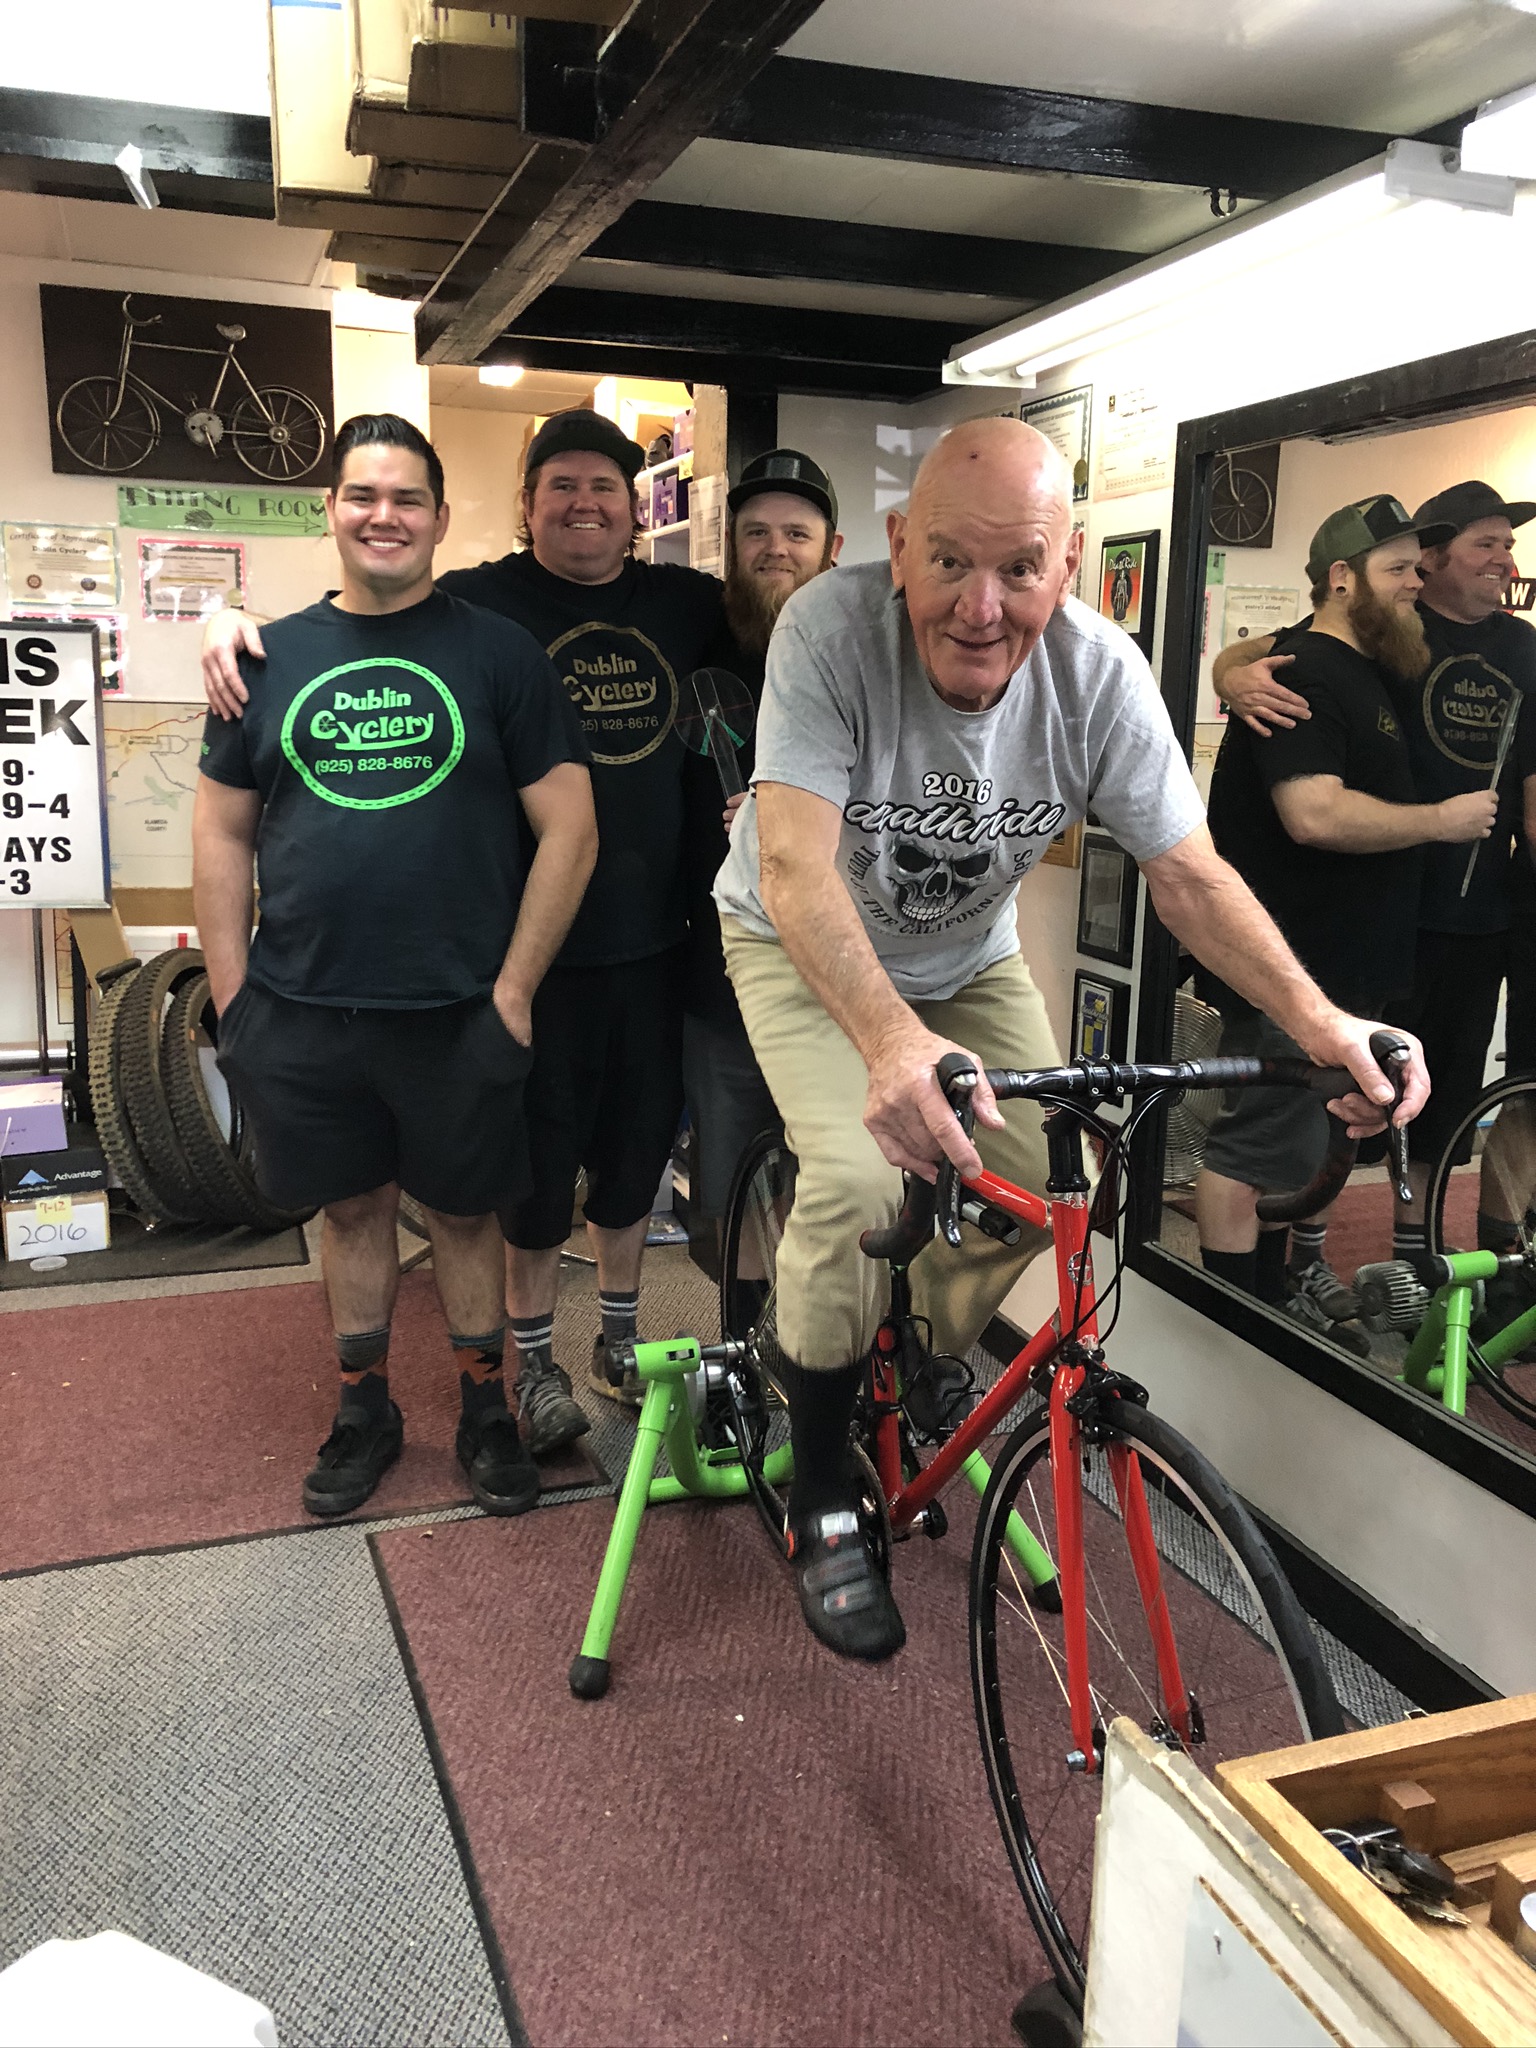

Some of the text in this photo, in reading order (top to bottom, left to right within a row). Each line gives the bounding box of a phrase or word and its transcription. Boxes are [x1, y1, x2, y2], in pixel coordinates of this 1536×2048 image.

[573, 653, 637, 675] Dublin
[333, 687, 412, 711] Dublin
[562, 675, 657, 712] Cyclery
[309, 710, 435, 751] Cyclery
[580, 715, 659, 732] 25) 828-8676
[314, 756, 433, 776] (925) 828-8676
[923, 772, 993, 804] 2016
[861, 898, 899, 927] THE
[898, 896, 999, 936] CALIFORN
[53, 1168, 103, 1183] Advantage
[18, 1223, 88, 1247] 2016
